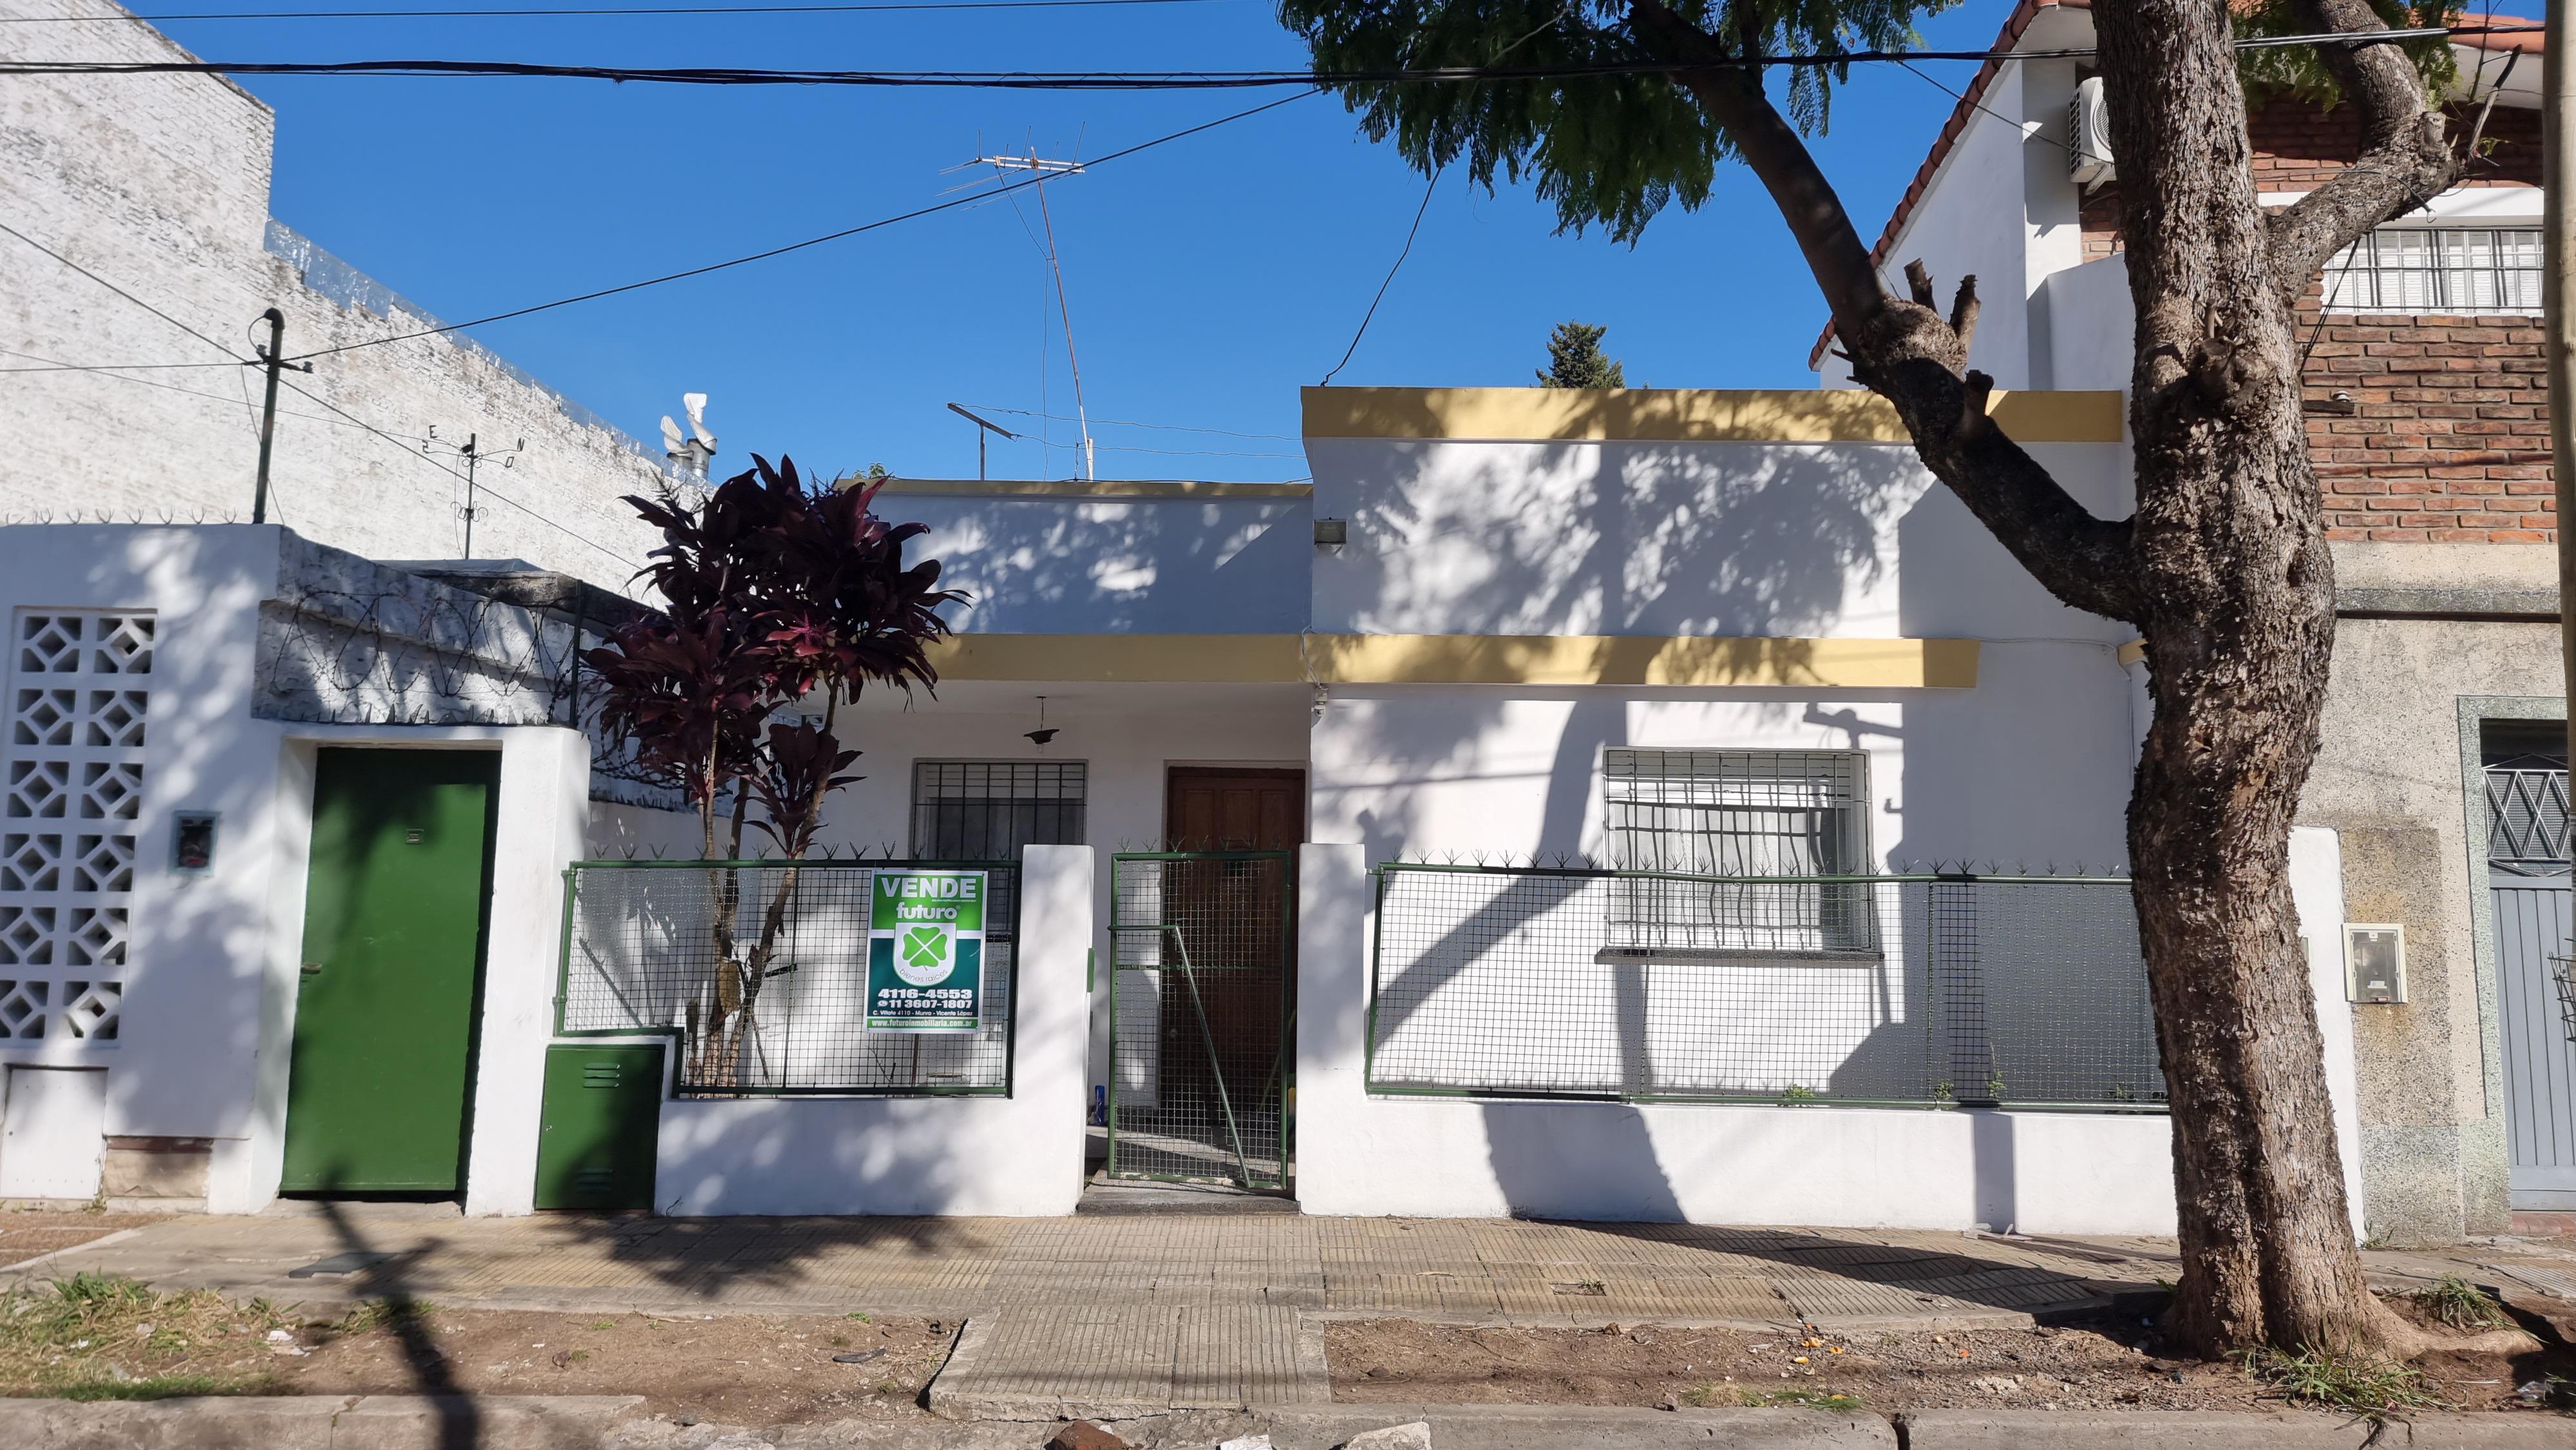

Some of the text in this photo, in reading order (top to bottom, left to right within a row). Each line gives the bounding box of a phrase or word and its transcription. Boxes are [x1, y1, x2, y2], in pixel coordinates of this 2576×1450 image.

[429, 424, 438, 438] E
[517, 437, 525, 451] N
[881, 877, 976, 898] VENDE
[896, 902, 958, 919] futuro
[899, 968, 923, 983] bienes
[878, 988, 972, 999] 4116-4553
[889, 999, 972, 1009] 11 3607-1807
